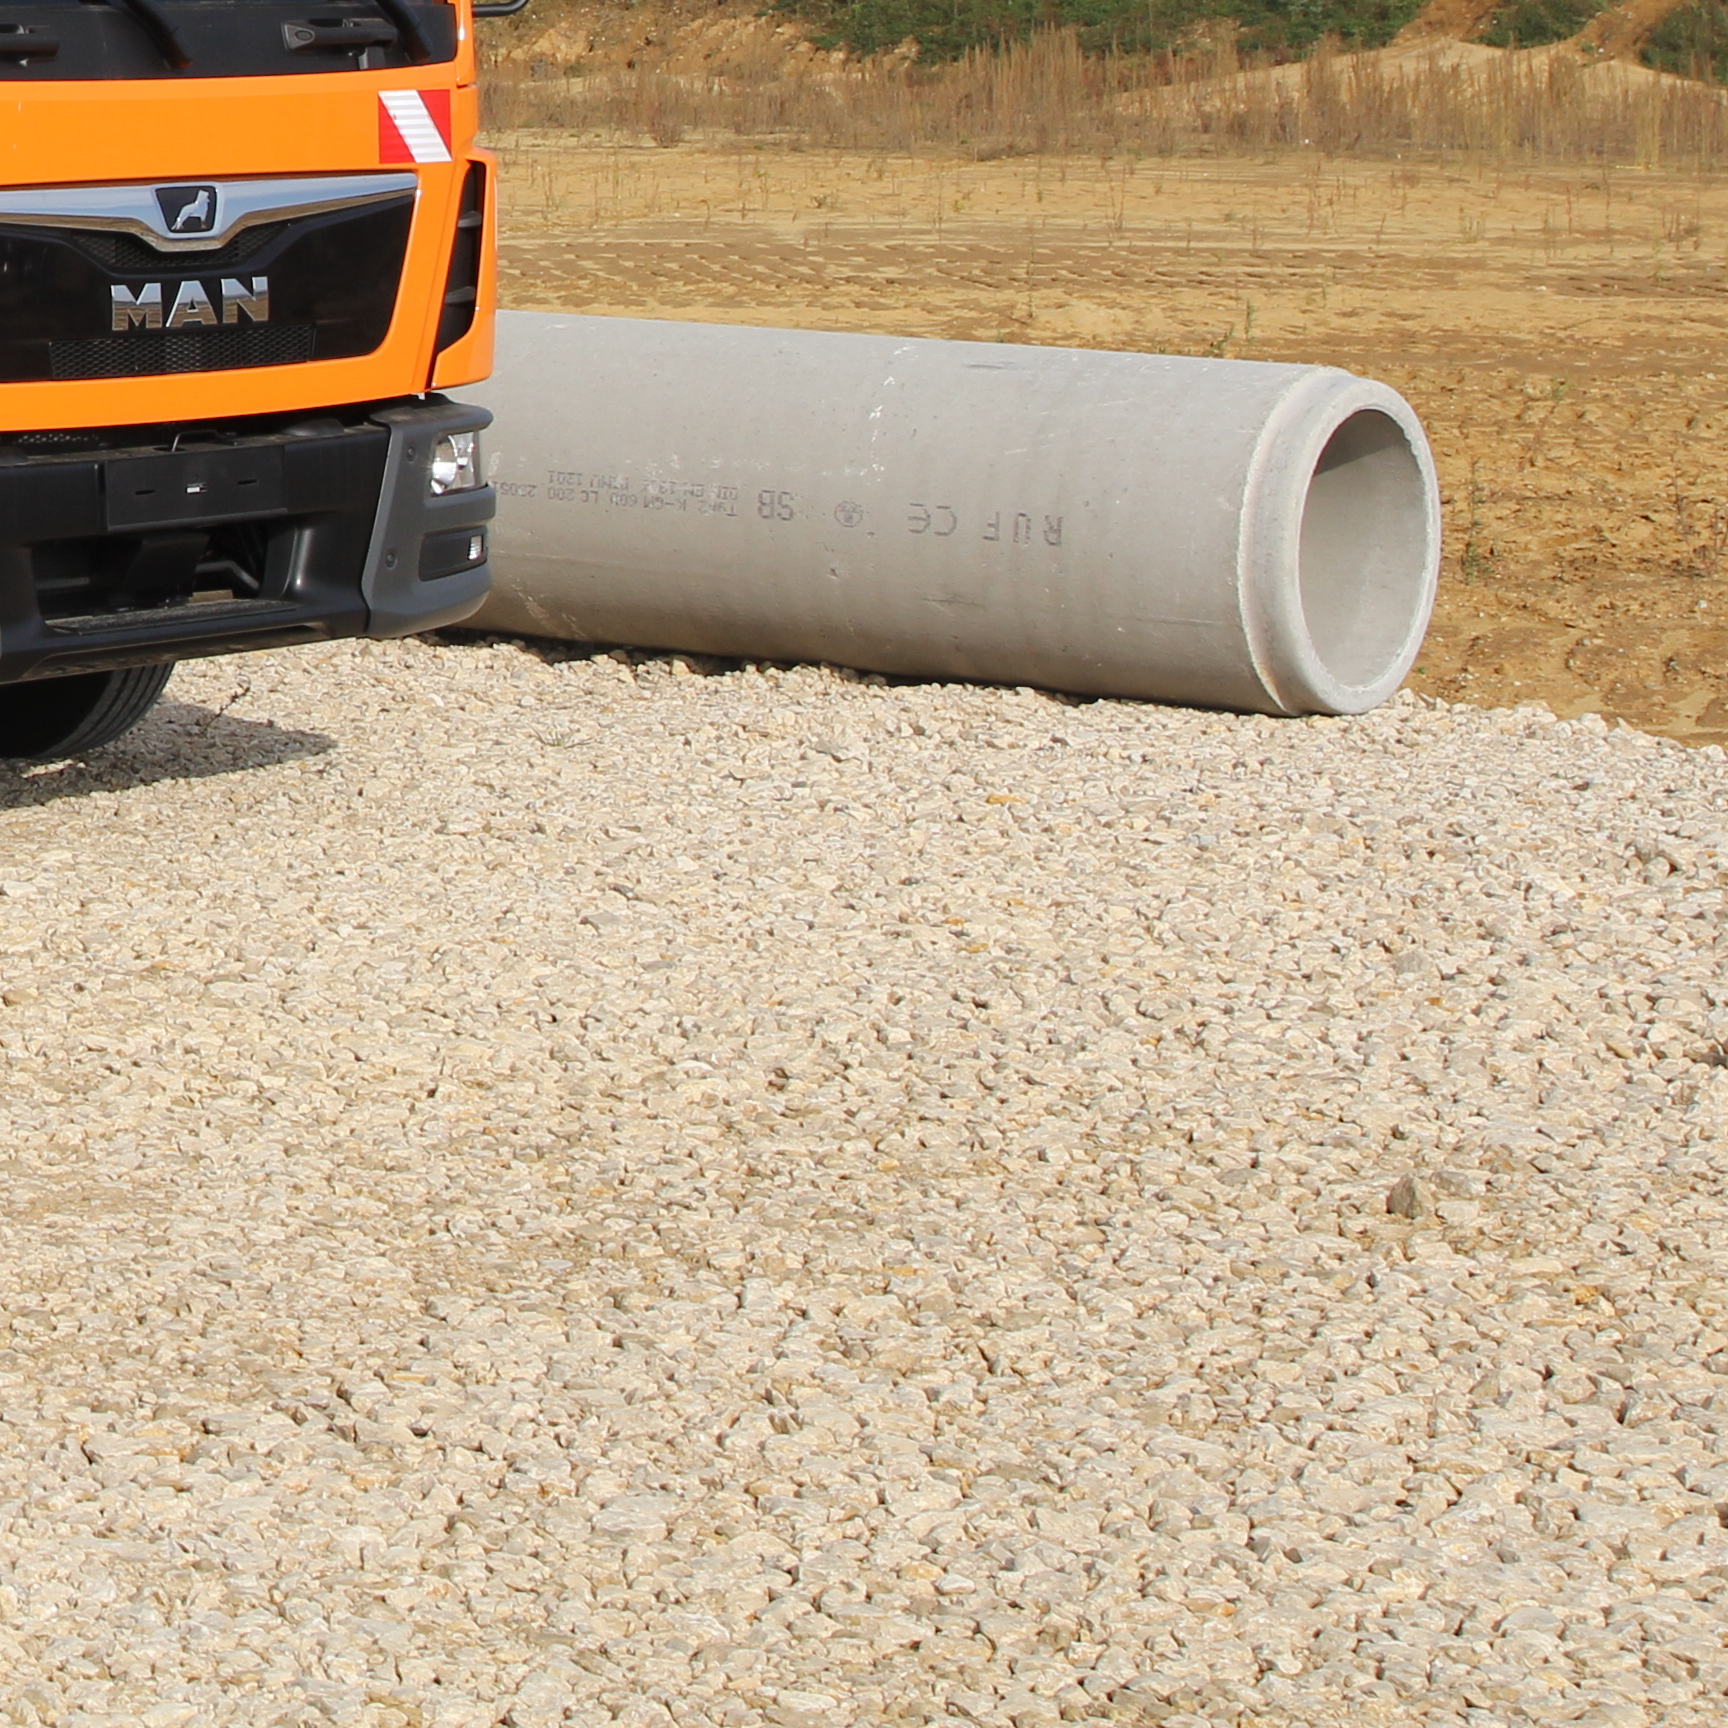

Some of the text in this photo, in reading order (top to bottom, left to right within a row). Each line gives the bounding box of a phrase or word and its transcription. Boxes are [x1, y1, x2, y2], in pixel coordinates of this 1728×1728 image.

[110, 276, 270, 331] MAN
[547, 469, 583, 486] 1201
[581, 490, 599, 504] LC
[757, 489, 794, 521] SB
